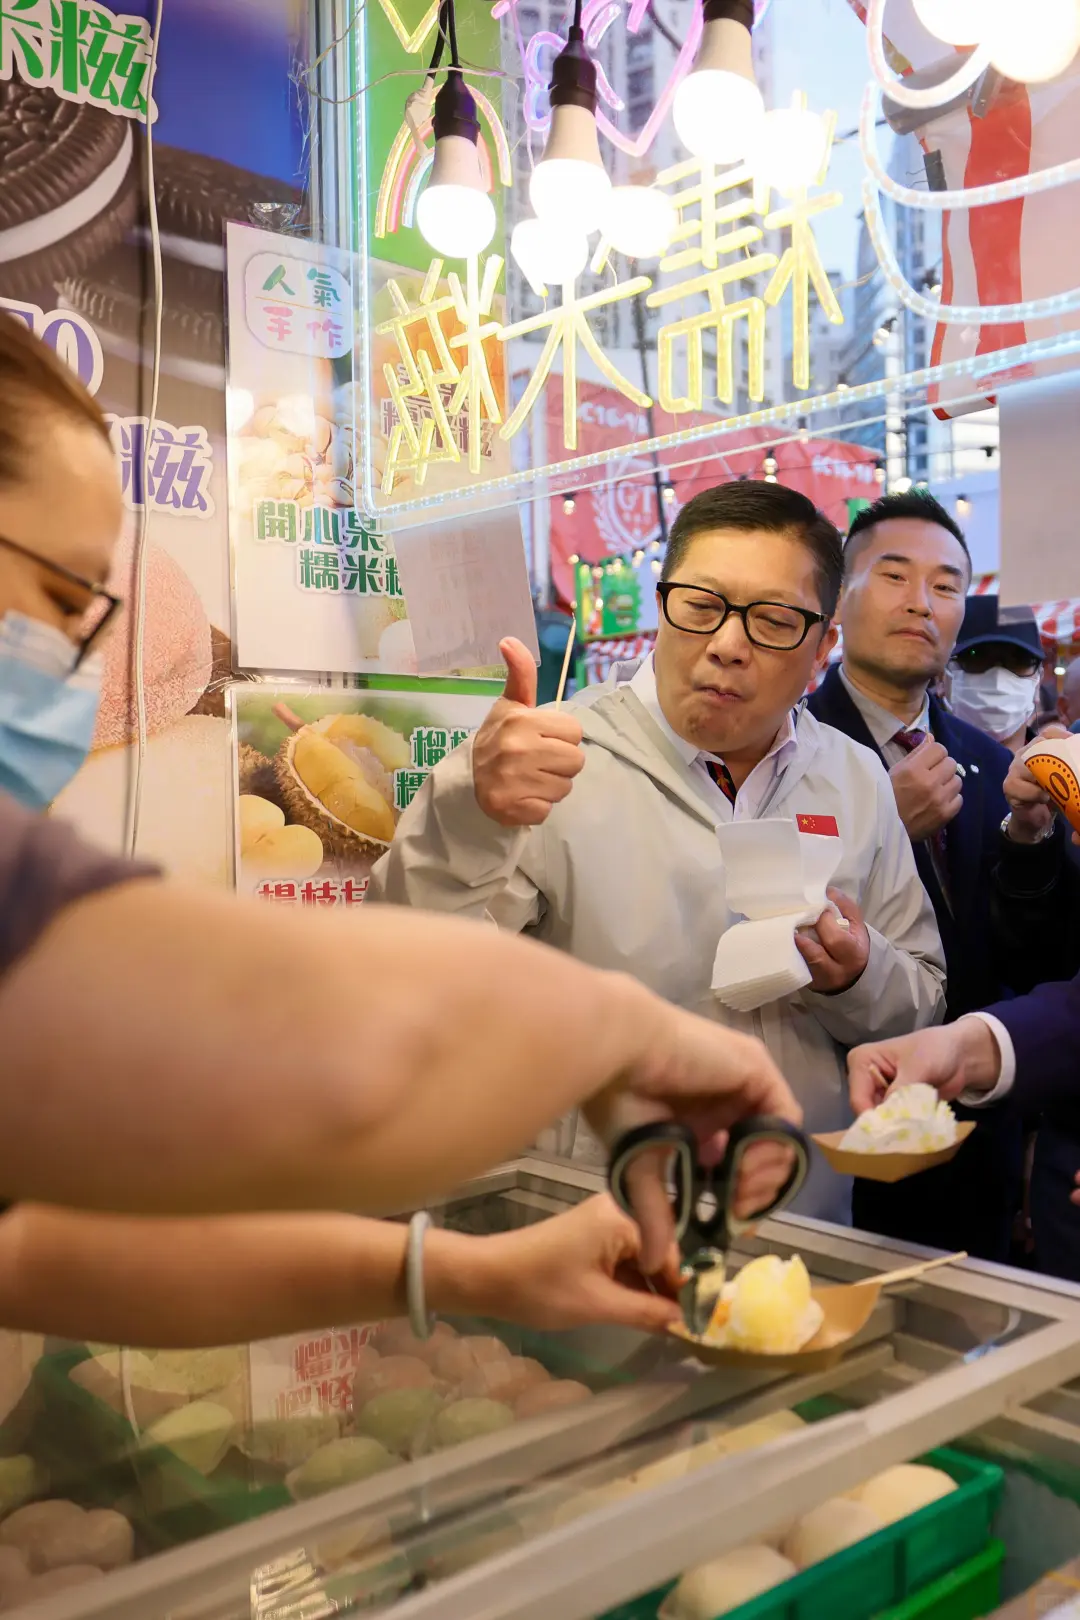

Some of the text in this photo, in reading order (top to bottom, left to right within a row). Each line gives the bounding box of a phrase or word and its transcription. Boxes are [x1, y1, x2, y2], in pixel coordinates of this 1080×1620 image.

[262, 264, 341, 307] 人氣
[262, 306, 343, 348] 手作
[103, 421, 208, 512] 糍
[257, 500, 384, 551] 開心果
